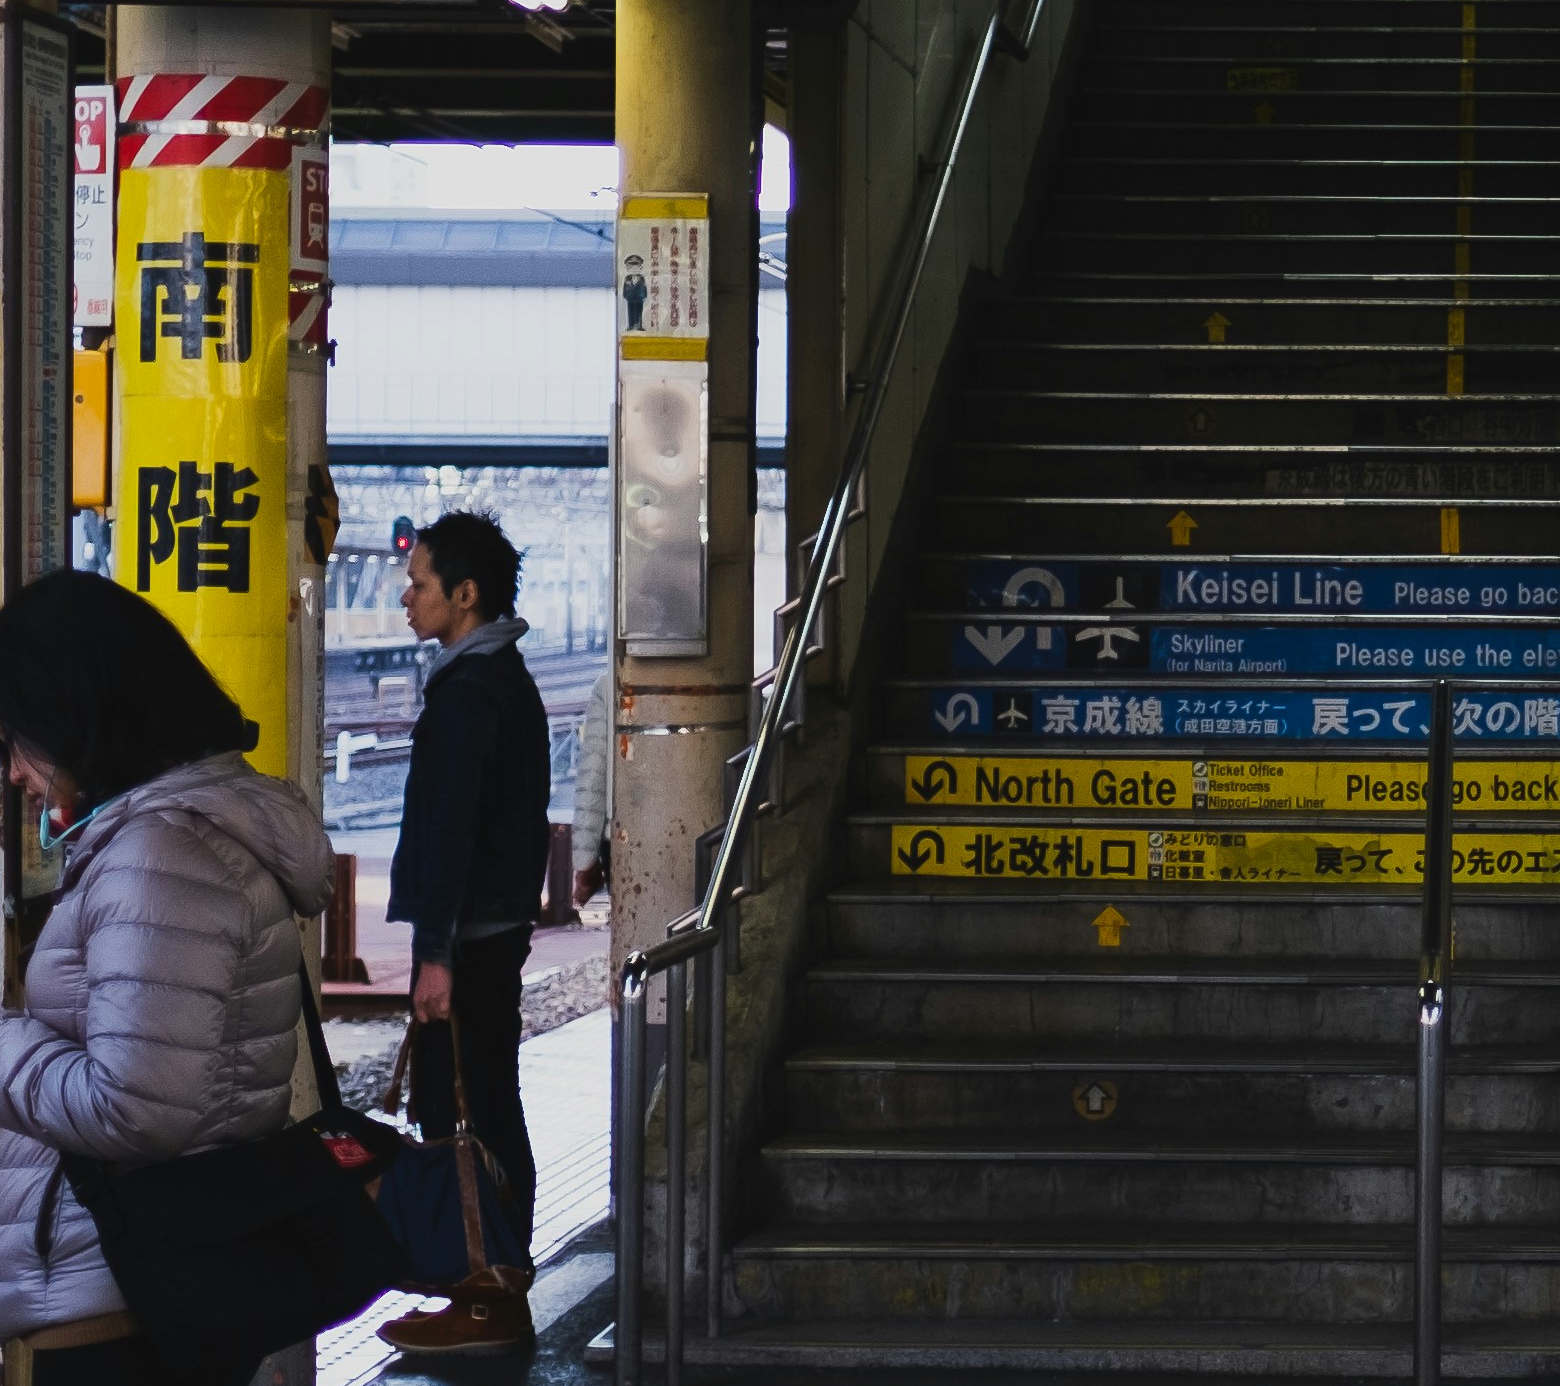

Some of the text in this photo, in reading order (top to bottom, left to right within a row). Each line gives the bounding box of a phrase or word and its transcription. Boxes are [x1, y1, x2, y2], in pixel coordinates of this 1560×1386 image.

[1176, 570, 1279, 605] Keisei
[1294, 572, 1363, 605] Line
[1394, 581, 1470, 606] Please
[1480, 588, 1508, 610] go
[1171, 633, 1245, 655] Skyliner
[1336, 643, 1414, 666] Please
[1425, 646, 1466, 667] use
[1476, 644, 1511, 667] the
[1166, 658, 1287, 673] (for Narita Airport)
[1041, 695, 1164, 735] 京成線
[1176, 699, 1287, 714] スカイライナー
[1209, 764, 1284, 776] Ticket Office
[974, 771, 1177, 807] North Gate
[1452, 779, 1481, 805] go
[1296, 797, 1325, 809] Liner
[964, 835, 1136, 876] 北改札口
